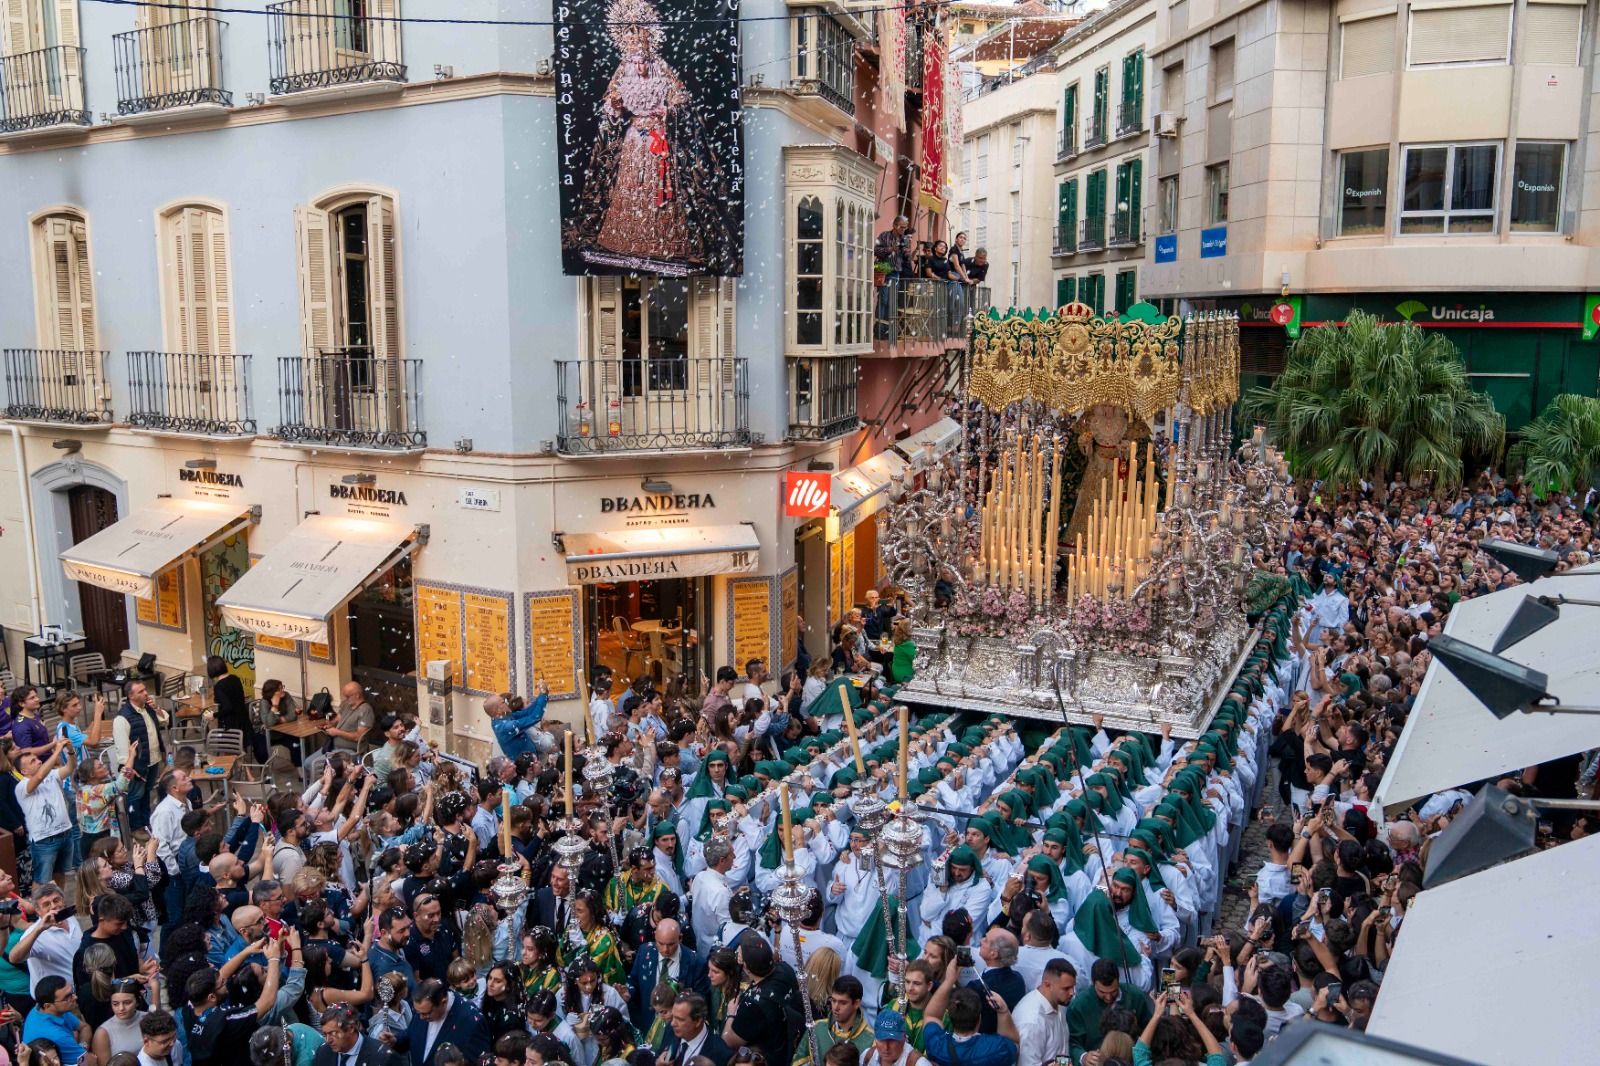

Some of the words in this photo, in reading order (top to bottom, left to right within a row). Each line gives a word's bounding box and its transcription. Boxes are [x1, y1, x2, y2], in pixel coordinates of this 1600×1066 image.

[560, 72, 574, 186] nostra
[731, 110, 741, 191] plena
[1431, 304, 1495, 322] Unicaja
[789, 479, 828, 513] illy
